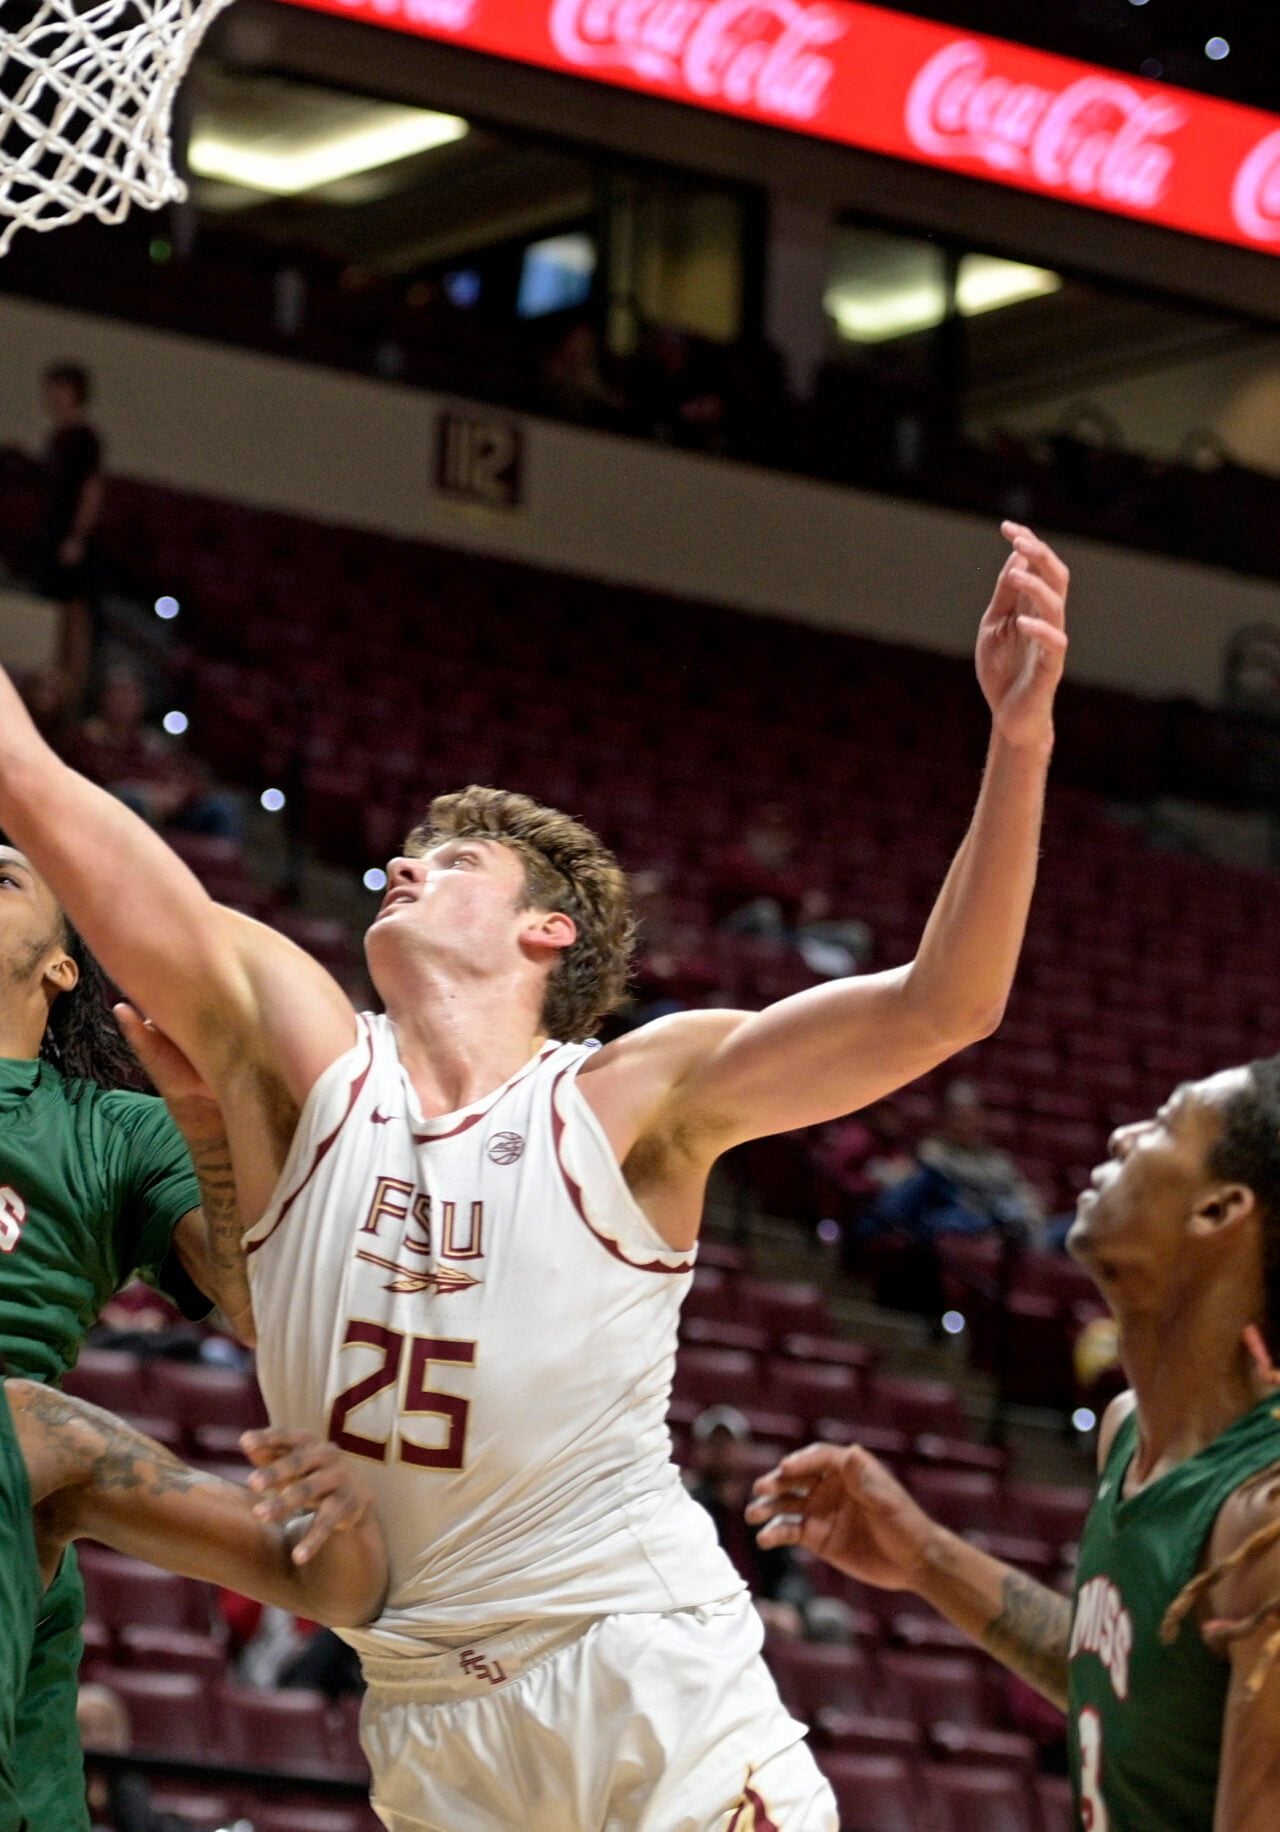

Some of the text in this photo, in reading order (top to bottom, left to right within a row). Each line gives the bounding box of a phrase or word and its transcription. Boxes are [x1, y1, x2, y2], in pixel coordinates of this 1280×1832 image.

[358, 1175, 485, 1261] FSU
[325, 1316, 478, 1474] 25
[459, 1648, 508, 1686] FSU
[1067, 1576, 1132, 1701] MISS
